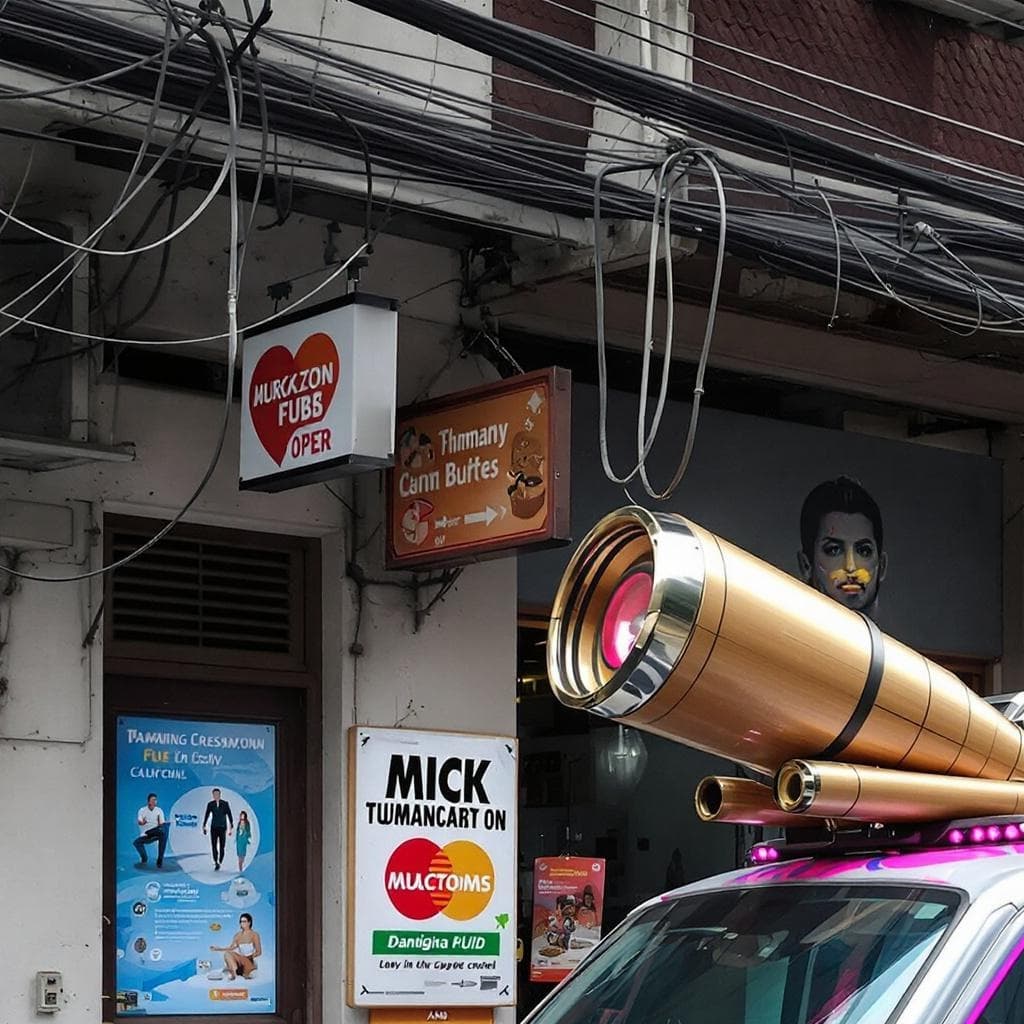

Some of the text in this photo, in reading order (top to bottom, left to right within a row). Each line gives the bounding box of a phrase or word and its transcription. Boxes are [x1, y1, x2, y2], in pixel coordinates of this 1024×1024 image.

[291, 429, 332, 458] OPER
[385, 754, 492, 804] MICK
[485, 809, 507, 832] ON
